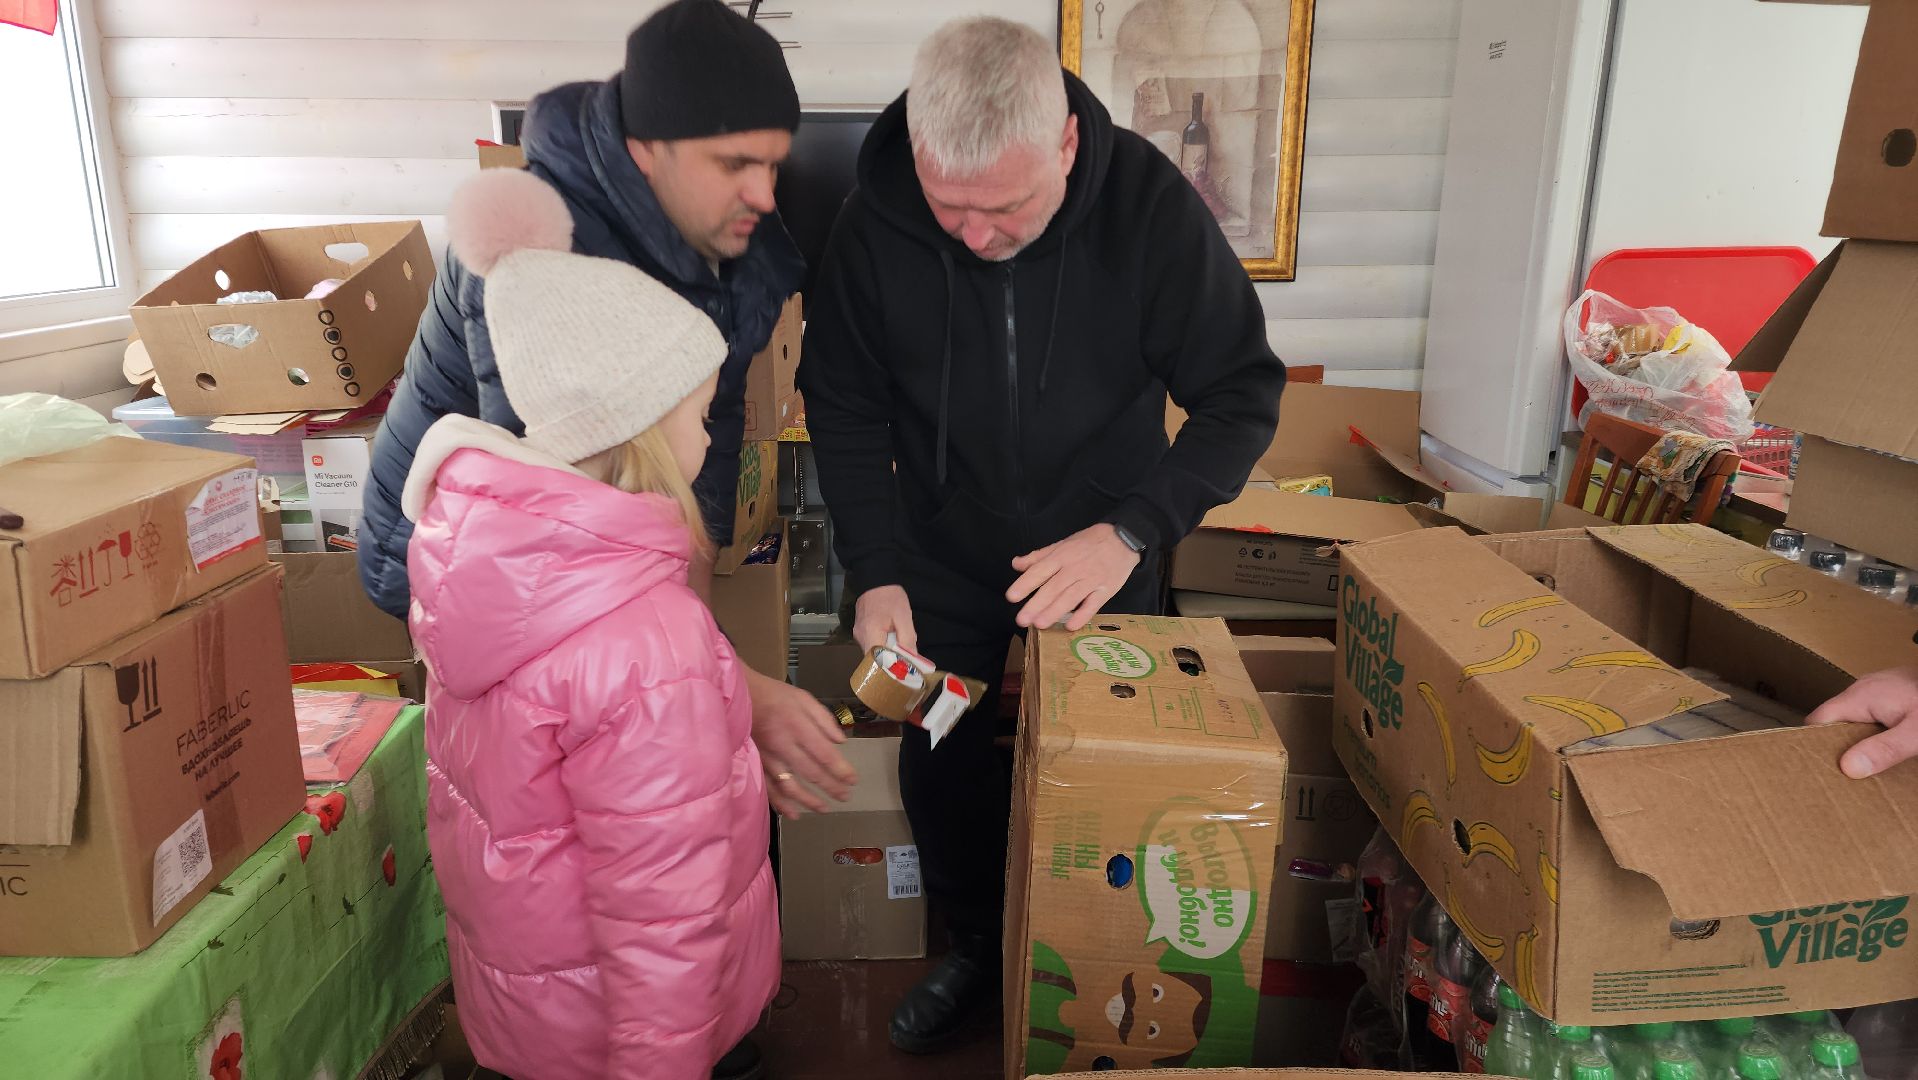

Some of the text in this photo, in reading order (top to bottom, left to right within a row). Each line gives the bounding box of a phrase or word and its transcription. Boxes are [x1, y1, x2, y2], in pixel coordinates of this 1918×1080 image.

[1343, 574, 1398, 660] Global
[1345, 624, 1404, 731] Village
[176, 690, 250, 757] FABERLIC
[1160, 850, 1208, 948] удобно!
[1757, 917, 1909, 968] Village
